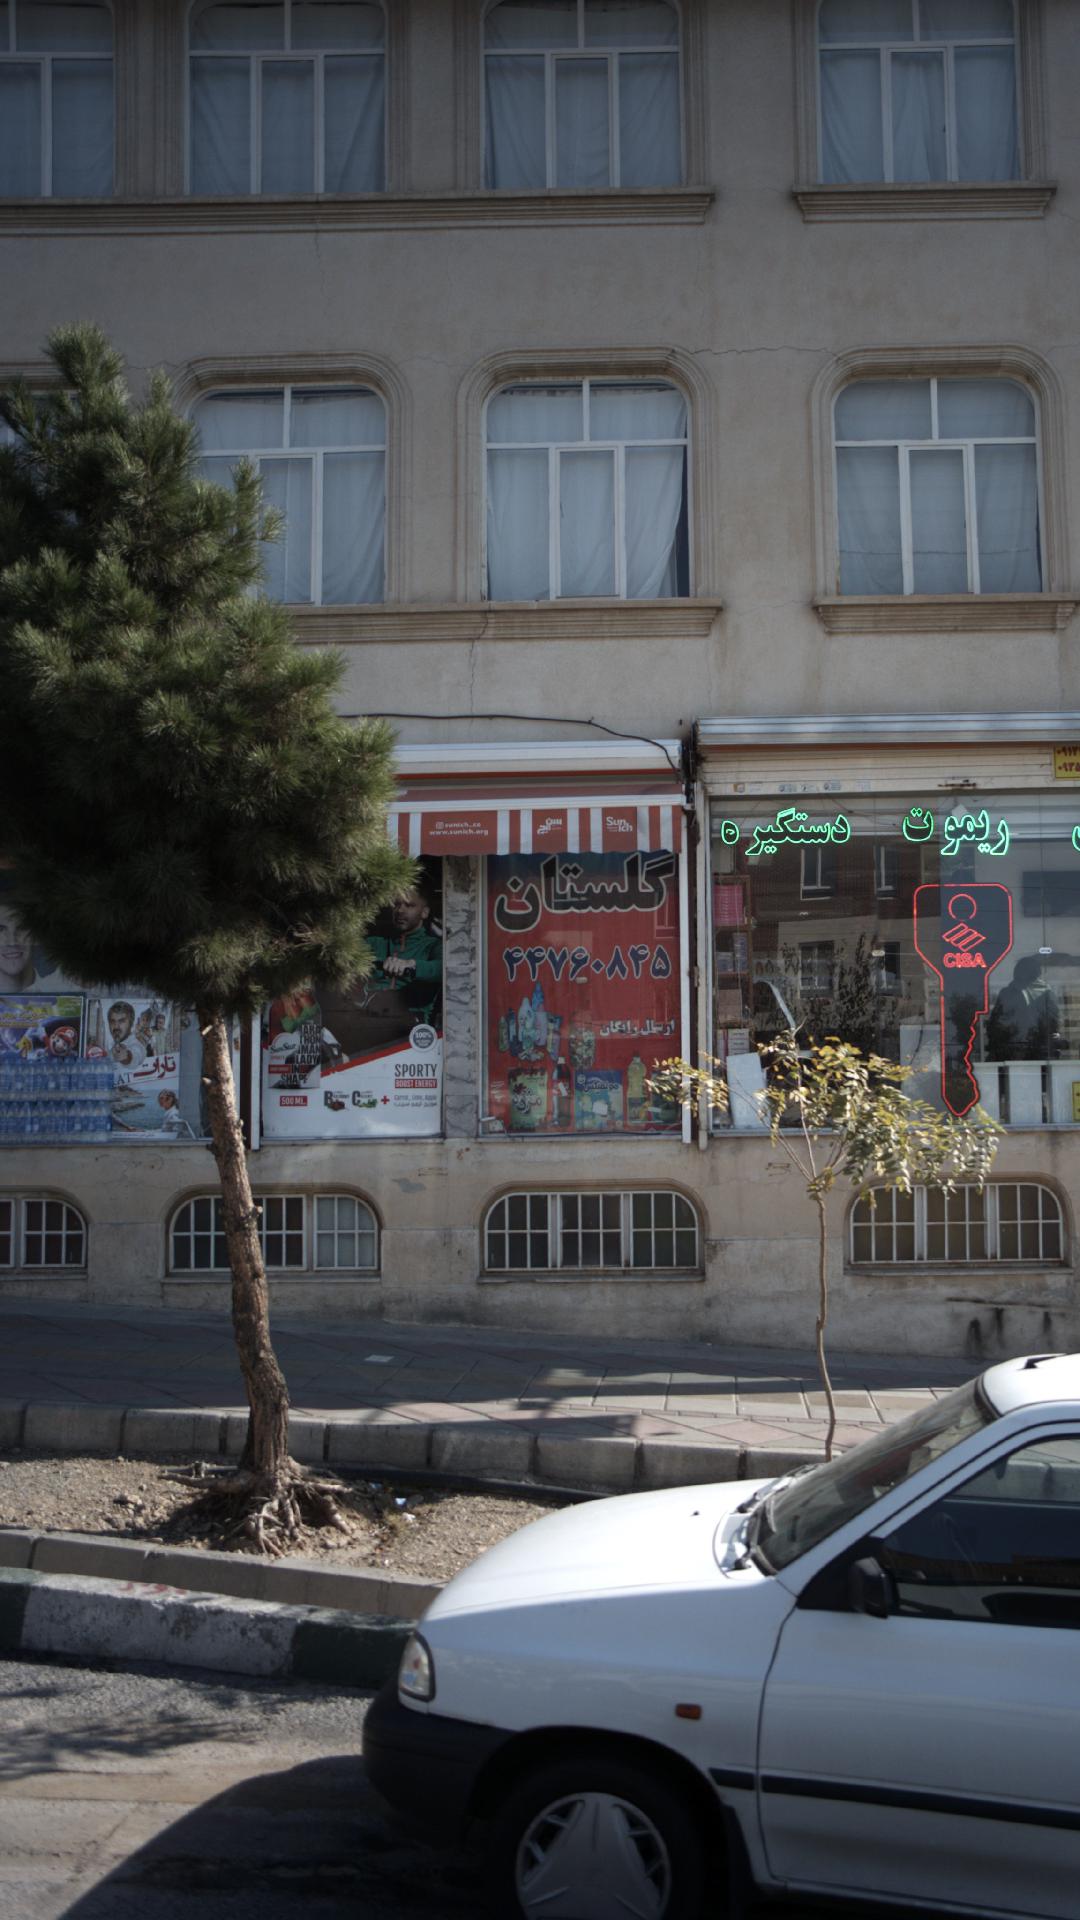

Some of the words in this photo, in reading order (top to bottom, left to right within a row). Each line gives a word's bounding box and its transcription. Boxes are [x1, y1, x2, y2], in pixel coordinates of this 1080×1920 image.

[494, 852, 676, 933] گلستان
[503, 944, 672, 982] ۴۴۷۶۰۸۴۵
[943, 952, 987, 968] CISA
[599, 1018, 638, 1037] رایگان
[640, 1017, 676, 1036] ارسال
[394, 1063, 437, 1077] SPORTY
